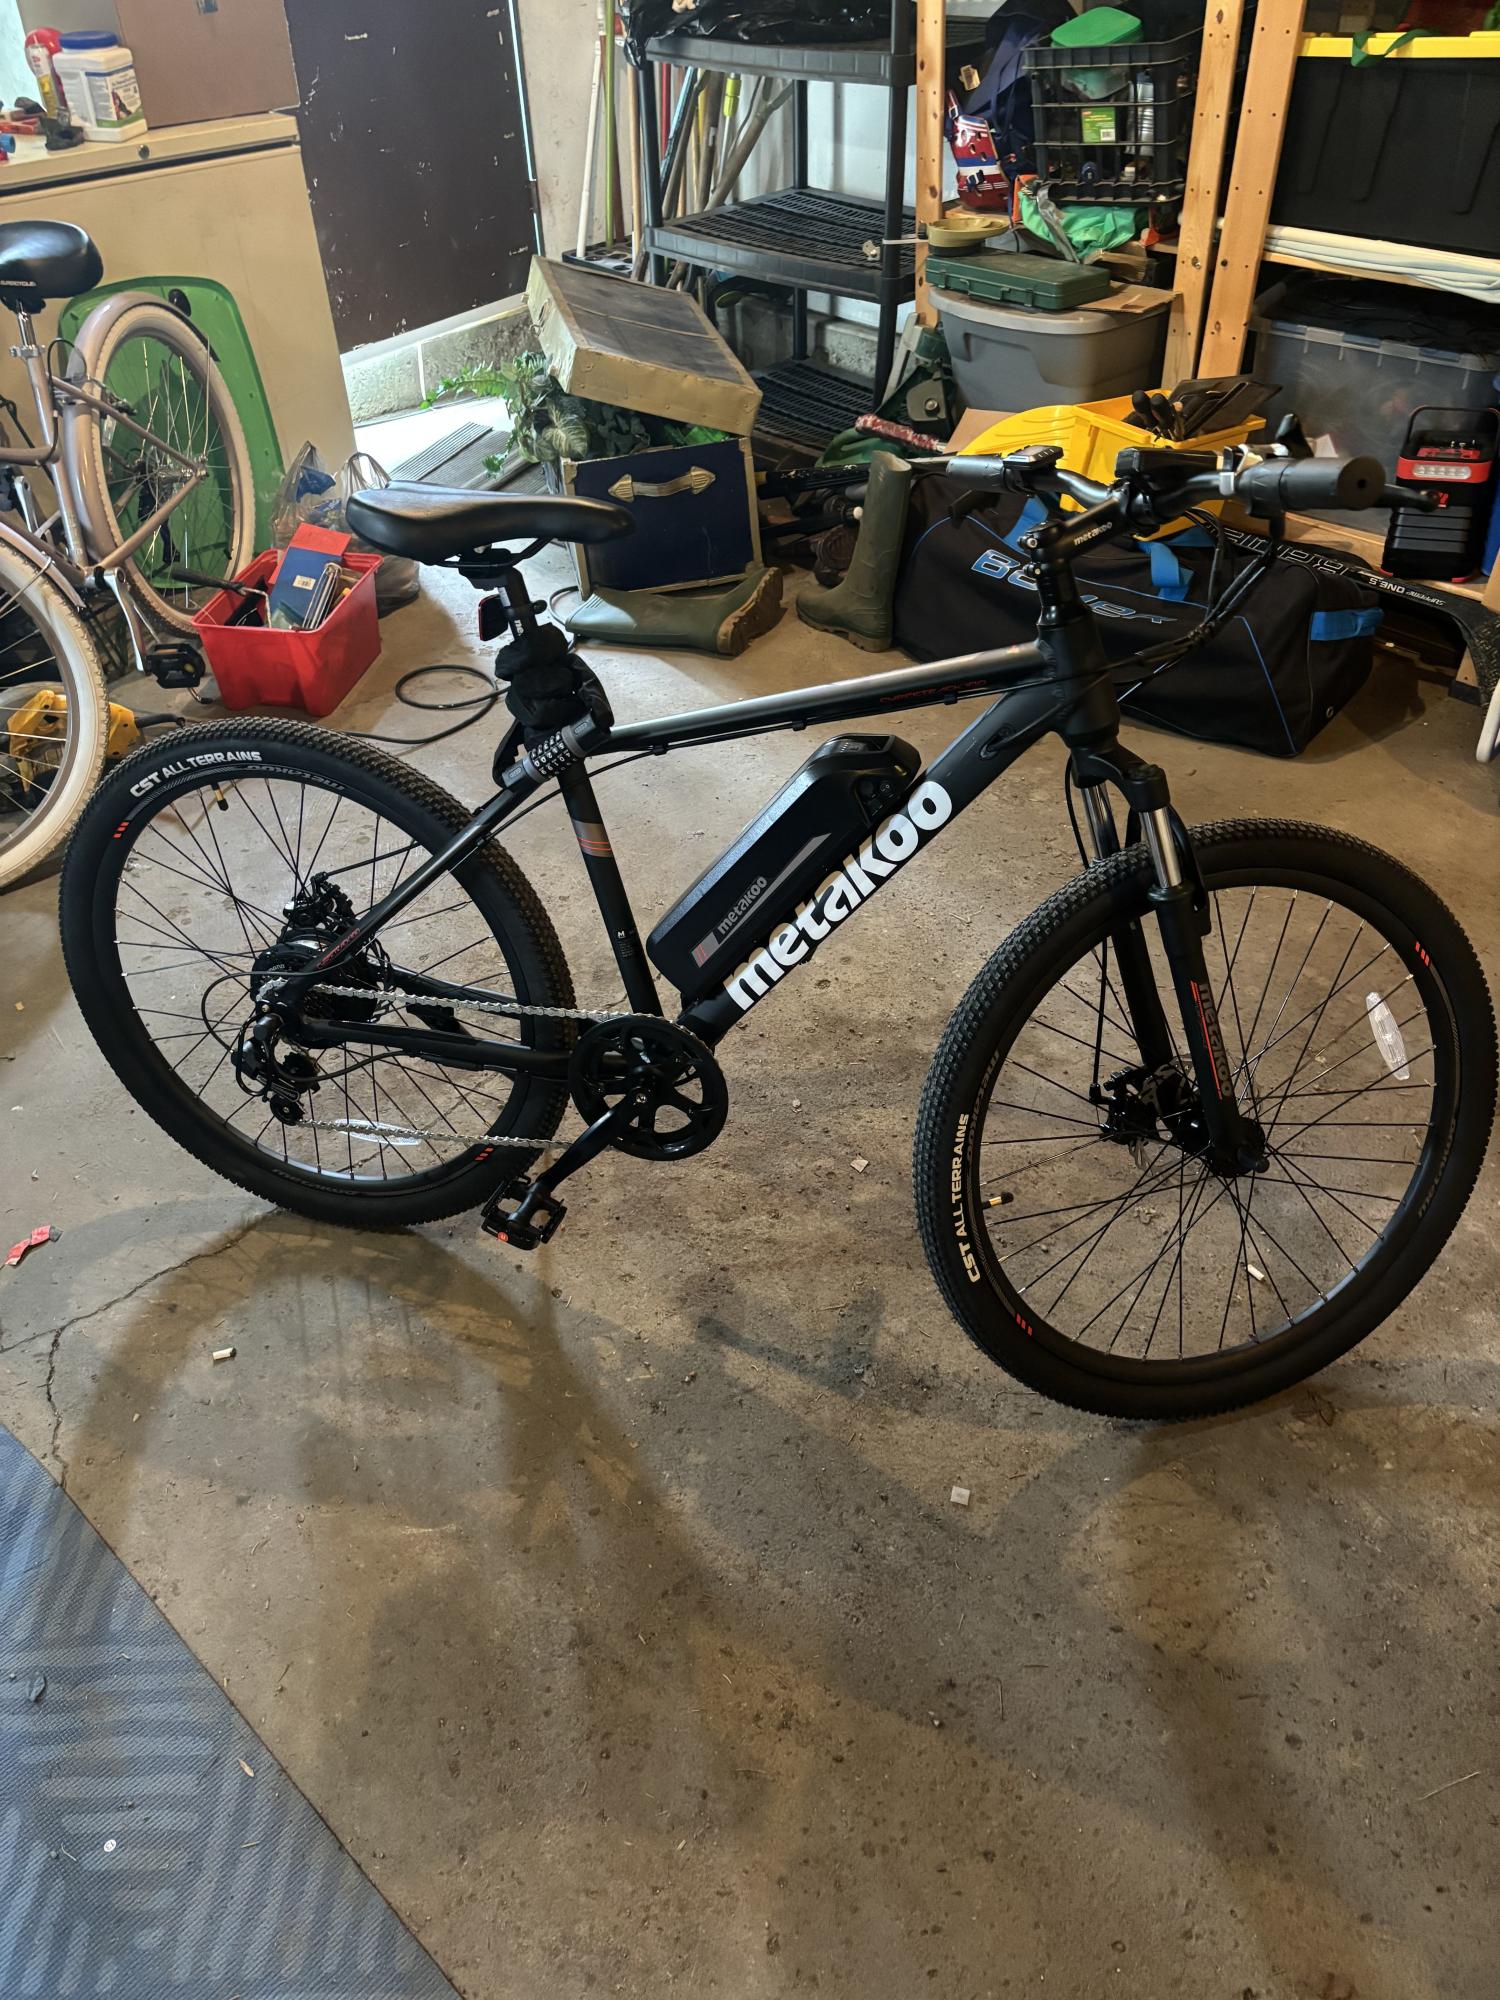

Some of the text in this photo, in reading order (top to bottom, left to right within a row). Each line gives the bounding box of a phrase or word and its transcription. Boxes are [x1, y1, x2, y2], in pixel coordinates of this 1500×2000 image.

[1073, 521, 1113, 546] metakoo
[130, 751, 262, 798] CST ALL TERRAINS
[717, 876, 768, 935] metakoo
[723, 781, 952, 1010] metakoo
[952, 1113, 981, 1283] CST ALL TERRAINS
